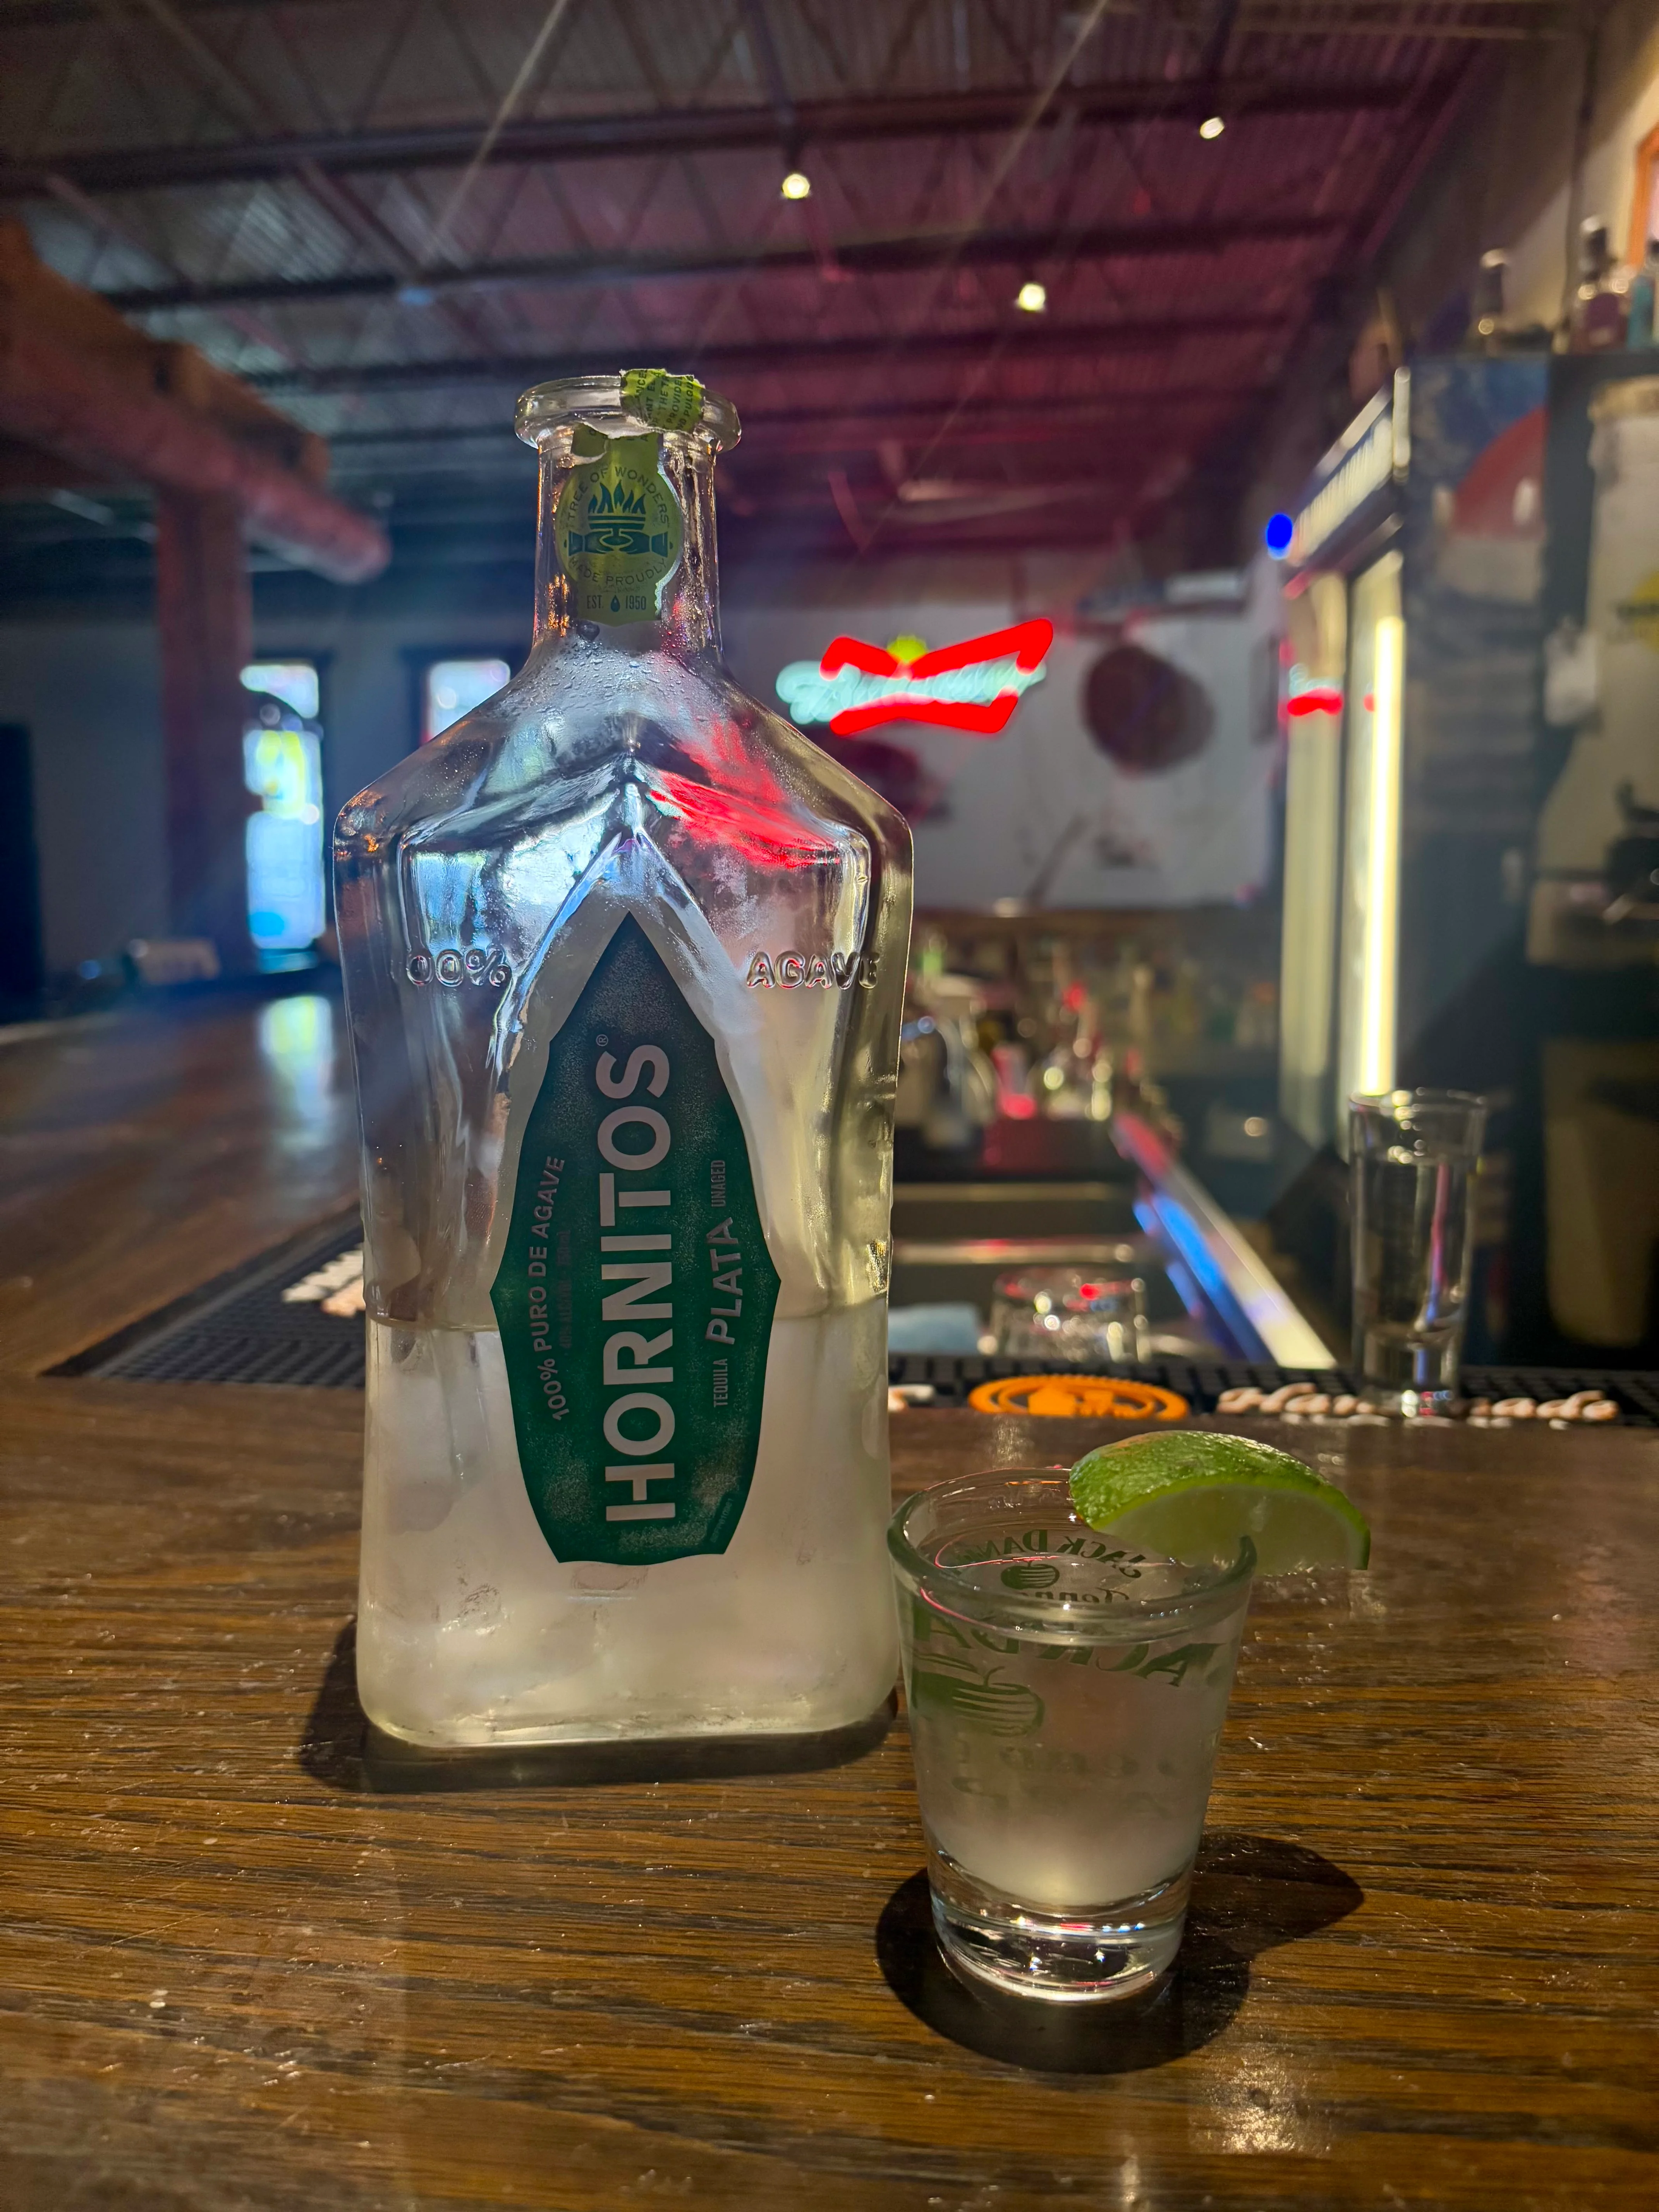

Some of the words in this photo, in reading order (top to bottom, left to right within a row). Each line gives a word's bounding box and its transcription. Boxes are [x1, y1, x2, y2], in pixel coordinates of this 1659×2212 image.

[568, 482, 588, 520] TREE
[590, 467, 608, 483] OF
[615, 466, 669, 524] WONDERS
[606, 558, 667, 585] PROUDLY
[626, 596, 646, 610] 1950
[746, 950, 880, 990] AGAVE
[531, 1156, 565, 1239] AGAVE
[711, 1160, 726, 1207] UNAGED
[528, 1247, 547, 1277] DE
[596, 1044, 675, 1521] HORNITOS
[705, 1217, 743, 1345] PLATA
[529, 1286, 552, 1352] PURO
[538, 1358, 569, 1421] 100%
[713, 1358, 728, 1408] TEQUILA
